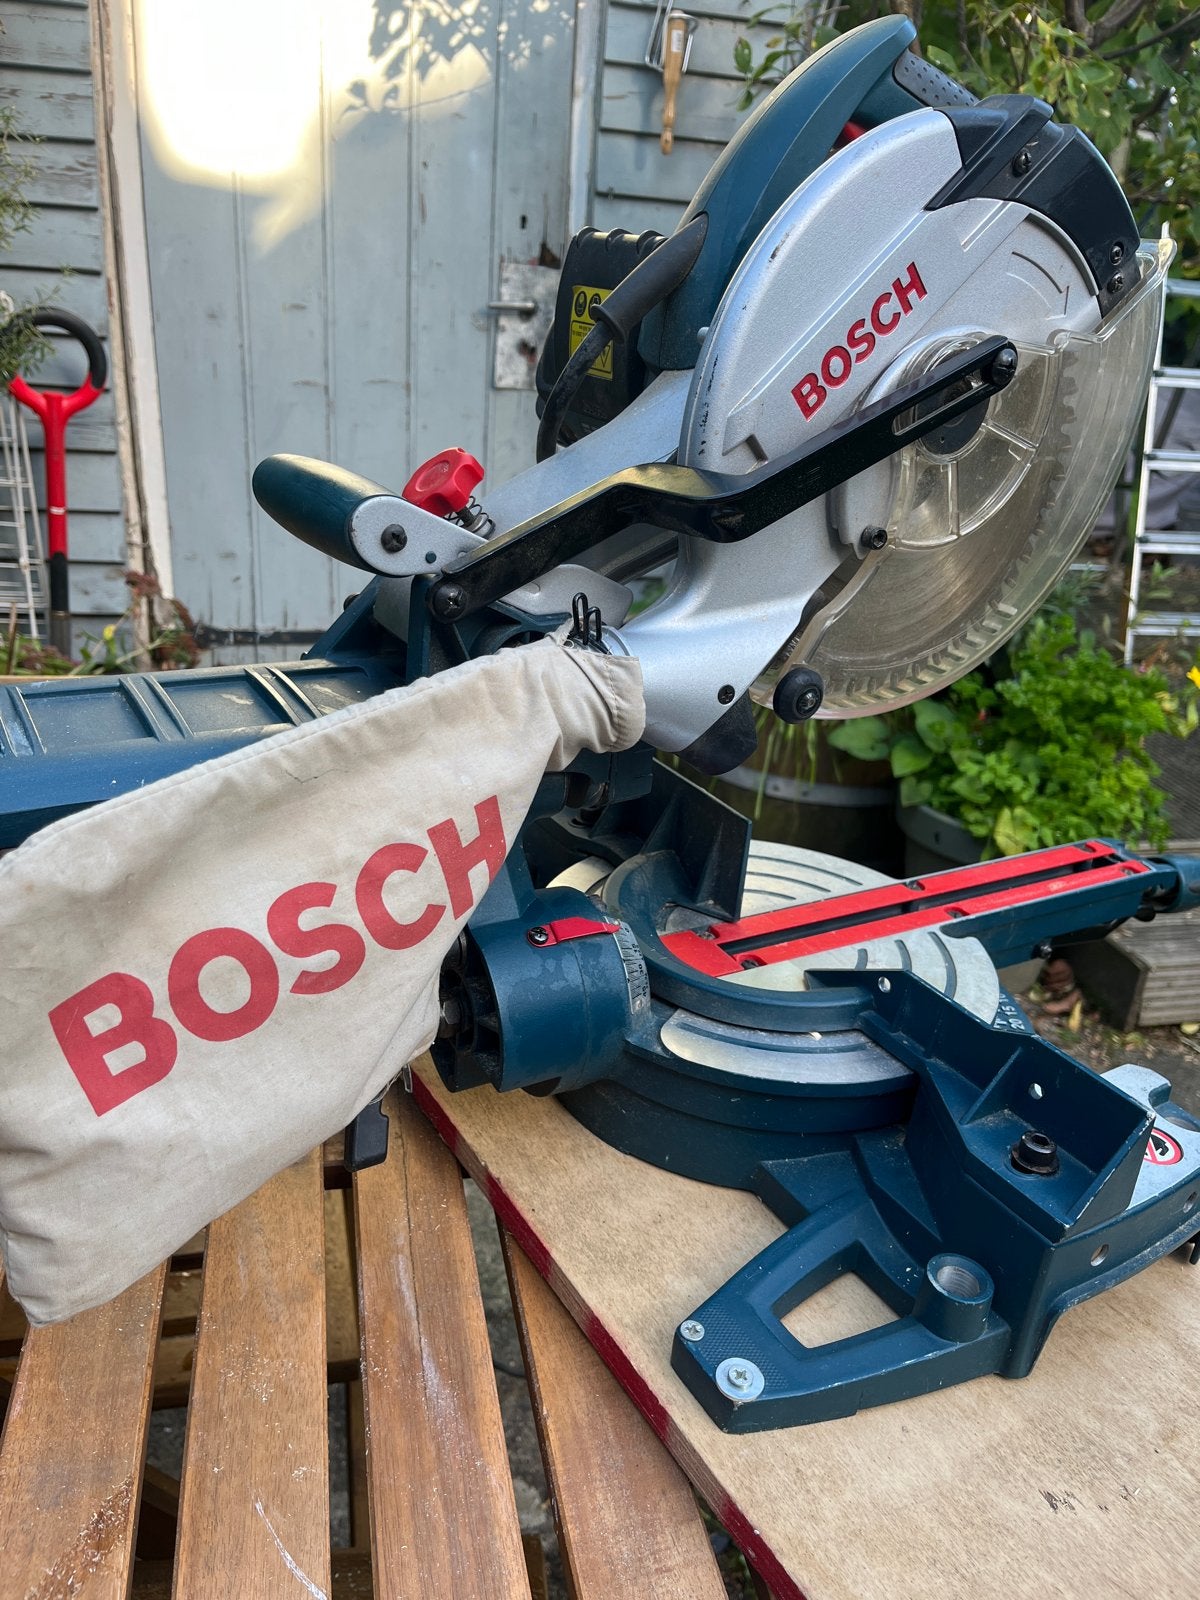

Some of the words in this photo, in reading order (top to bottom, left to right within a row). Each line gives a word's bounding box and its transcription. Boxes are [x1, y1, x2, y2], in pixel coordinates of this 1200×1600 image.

[791, 261, 928, 422] BOSCH
[49, 795, 507, 1117] BOSCH
[1001, 1005, 1018, 1015] 15
[1009, 1018, 1025, 1030] 20
